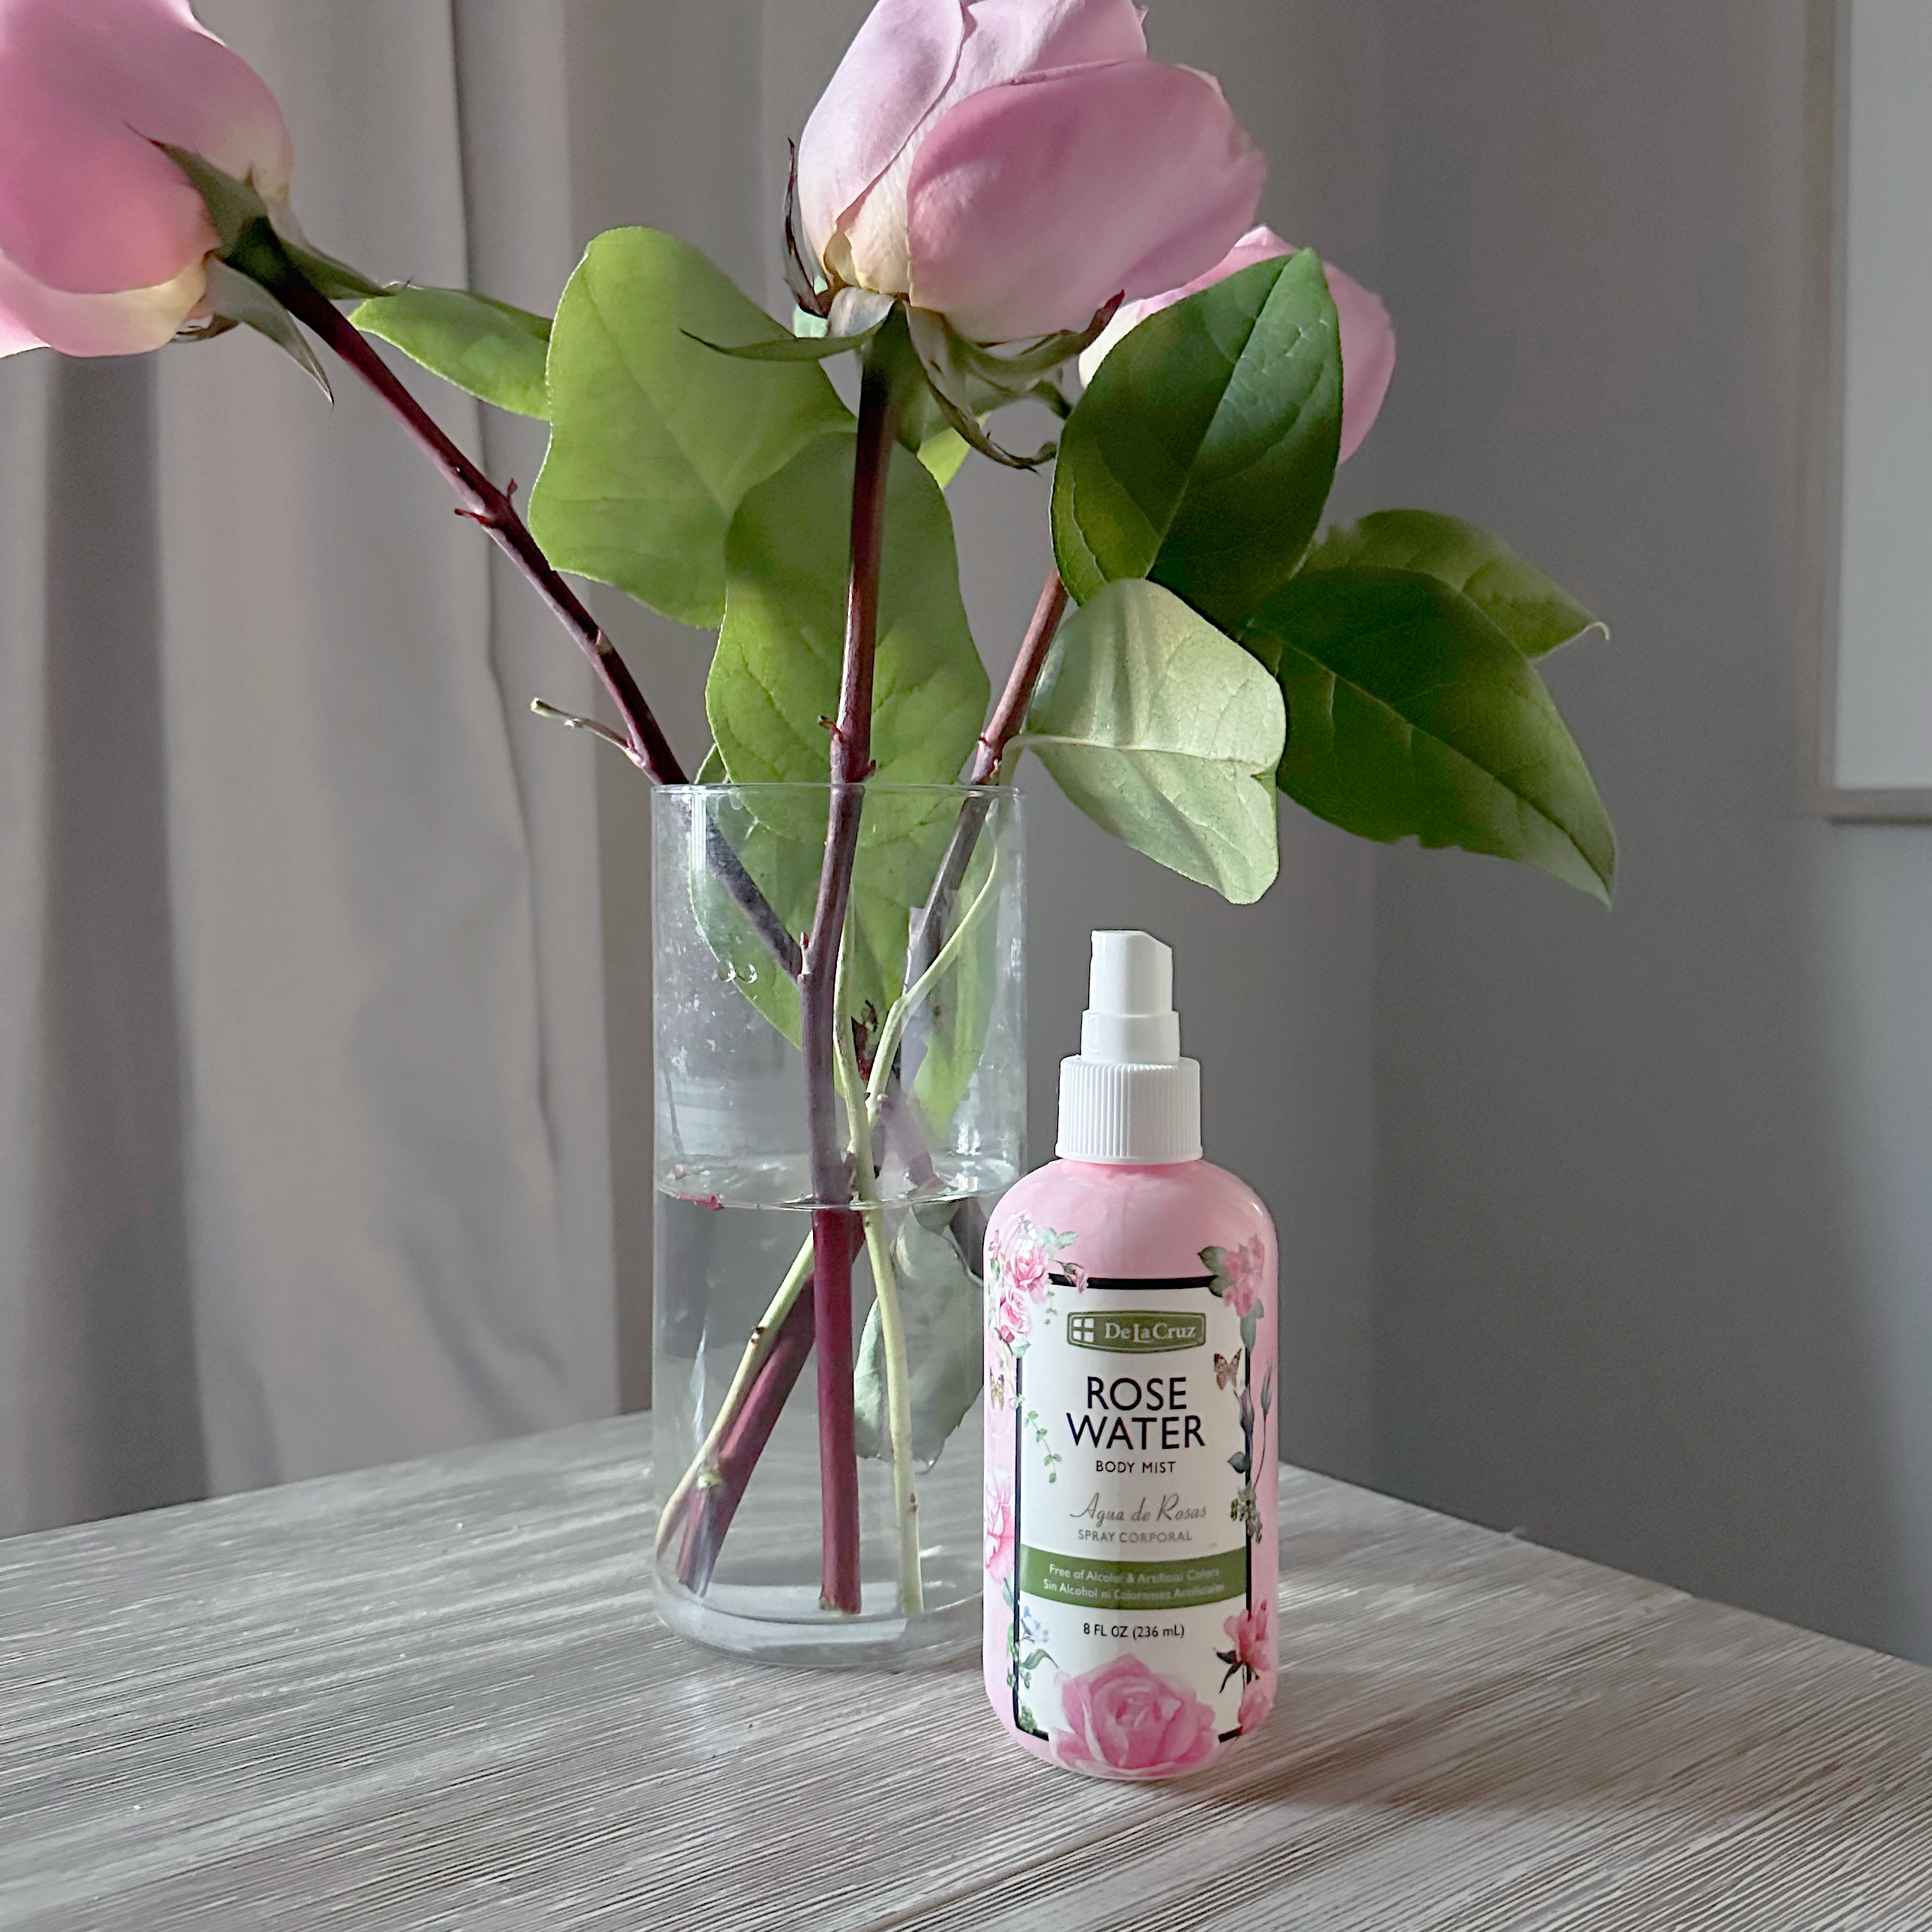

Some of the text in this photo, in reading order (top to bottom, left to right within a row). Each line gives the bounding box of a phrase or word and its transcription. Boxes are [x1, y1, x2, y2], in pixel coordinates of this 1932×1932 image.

[1087, 1376, 1187, 1410] ROSE
[1066, 1413, 1206, 1450] WATER
[1096, 1460, 1176, 1473] BODY MIST
[1070, 1492, 1207, 1528] Agua de Rosas
[1078, 1529, 1192, 1543] SPRAY CORPORAL
[1050, 1564, 1071, 1577] Free
[1073, 1569, 1085, 1580] of
[1086, 1570, 1123, 1582] Alcoho
[1044, 1578, 1057, 1591] Sin
[1059, 1583, 1097, 1599] Alcohol
[1083, 1623, 1185, 1641] 8 FL OZ (236 mL)
